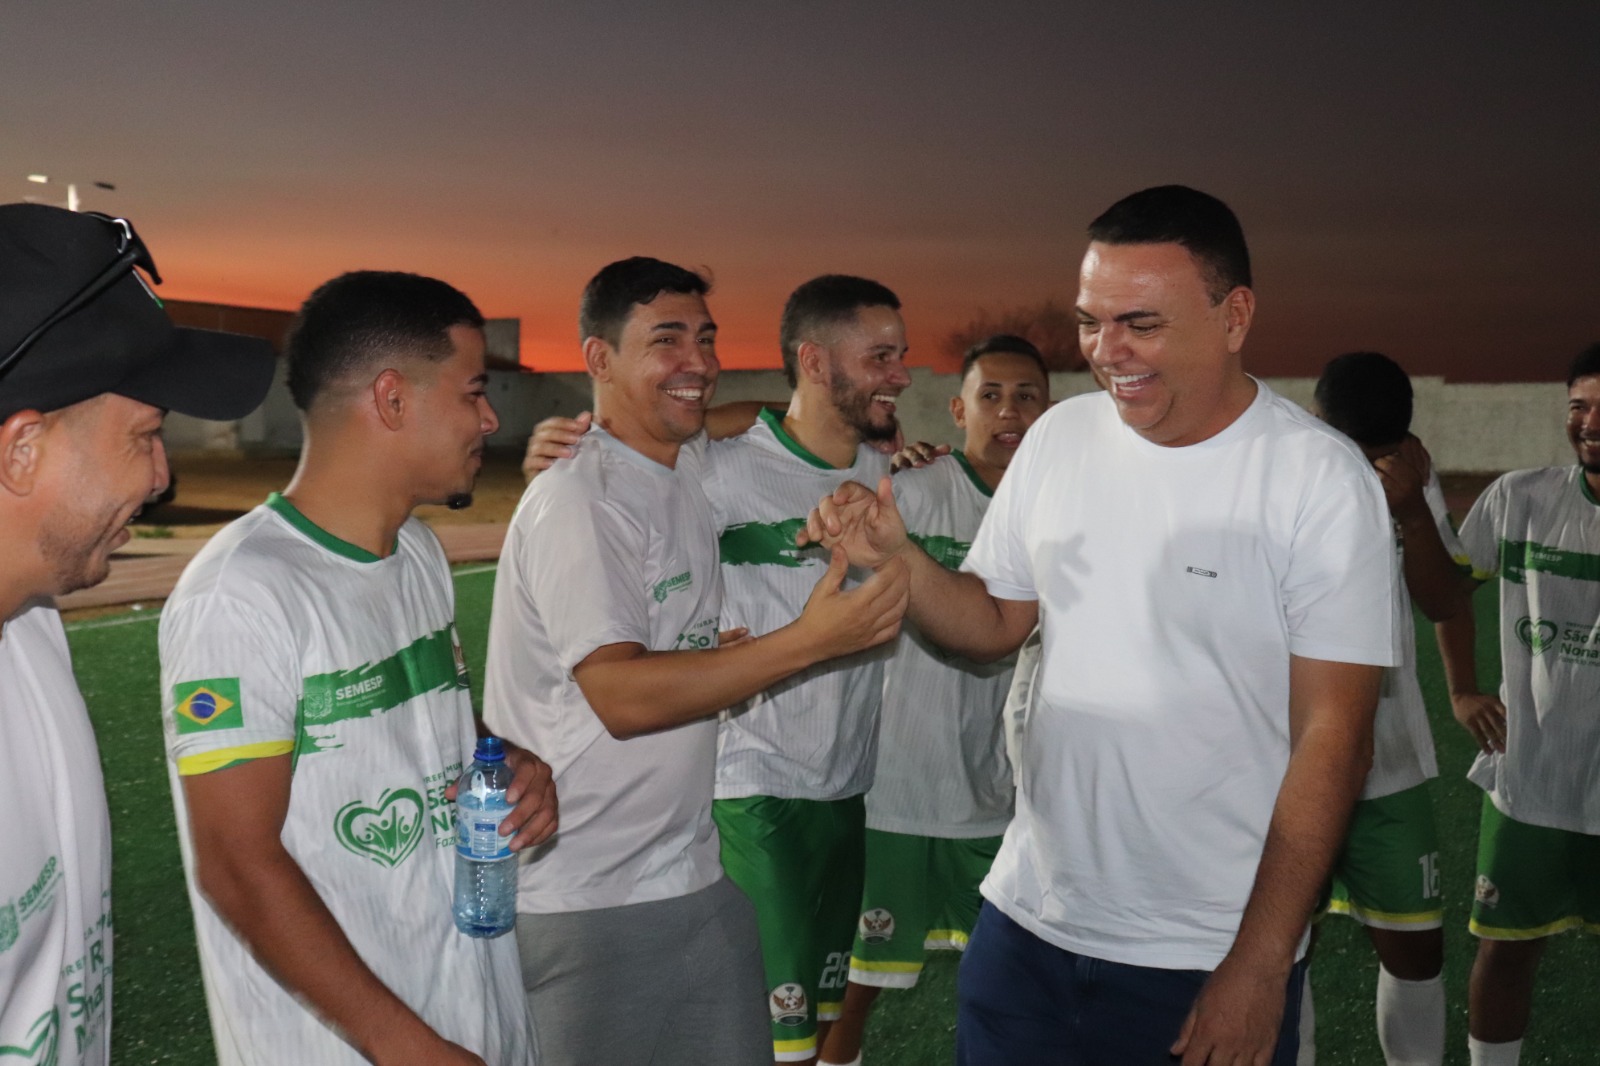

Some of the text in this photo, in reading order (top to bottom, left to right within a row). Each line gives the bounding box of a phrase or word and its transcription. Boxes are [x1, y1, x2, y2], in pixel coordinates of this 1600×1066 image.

[1563, 629, 1589, 643] São
[335, 674, 384, 701] SEMESP
[18, 855, 57, 914] SEMESP
[1418, 851, 1441, 899] 16
